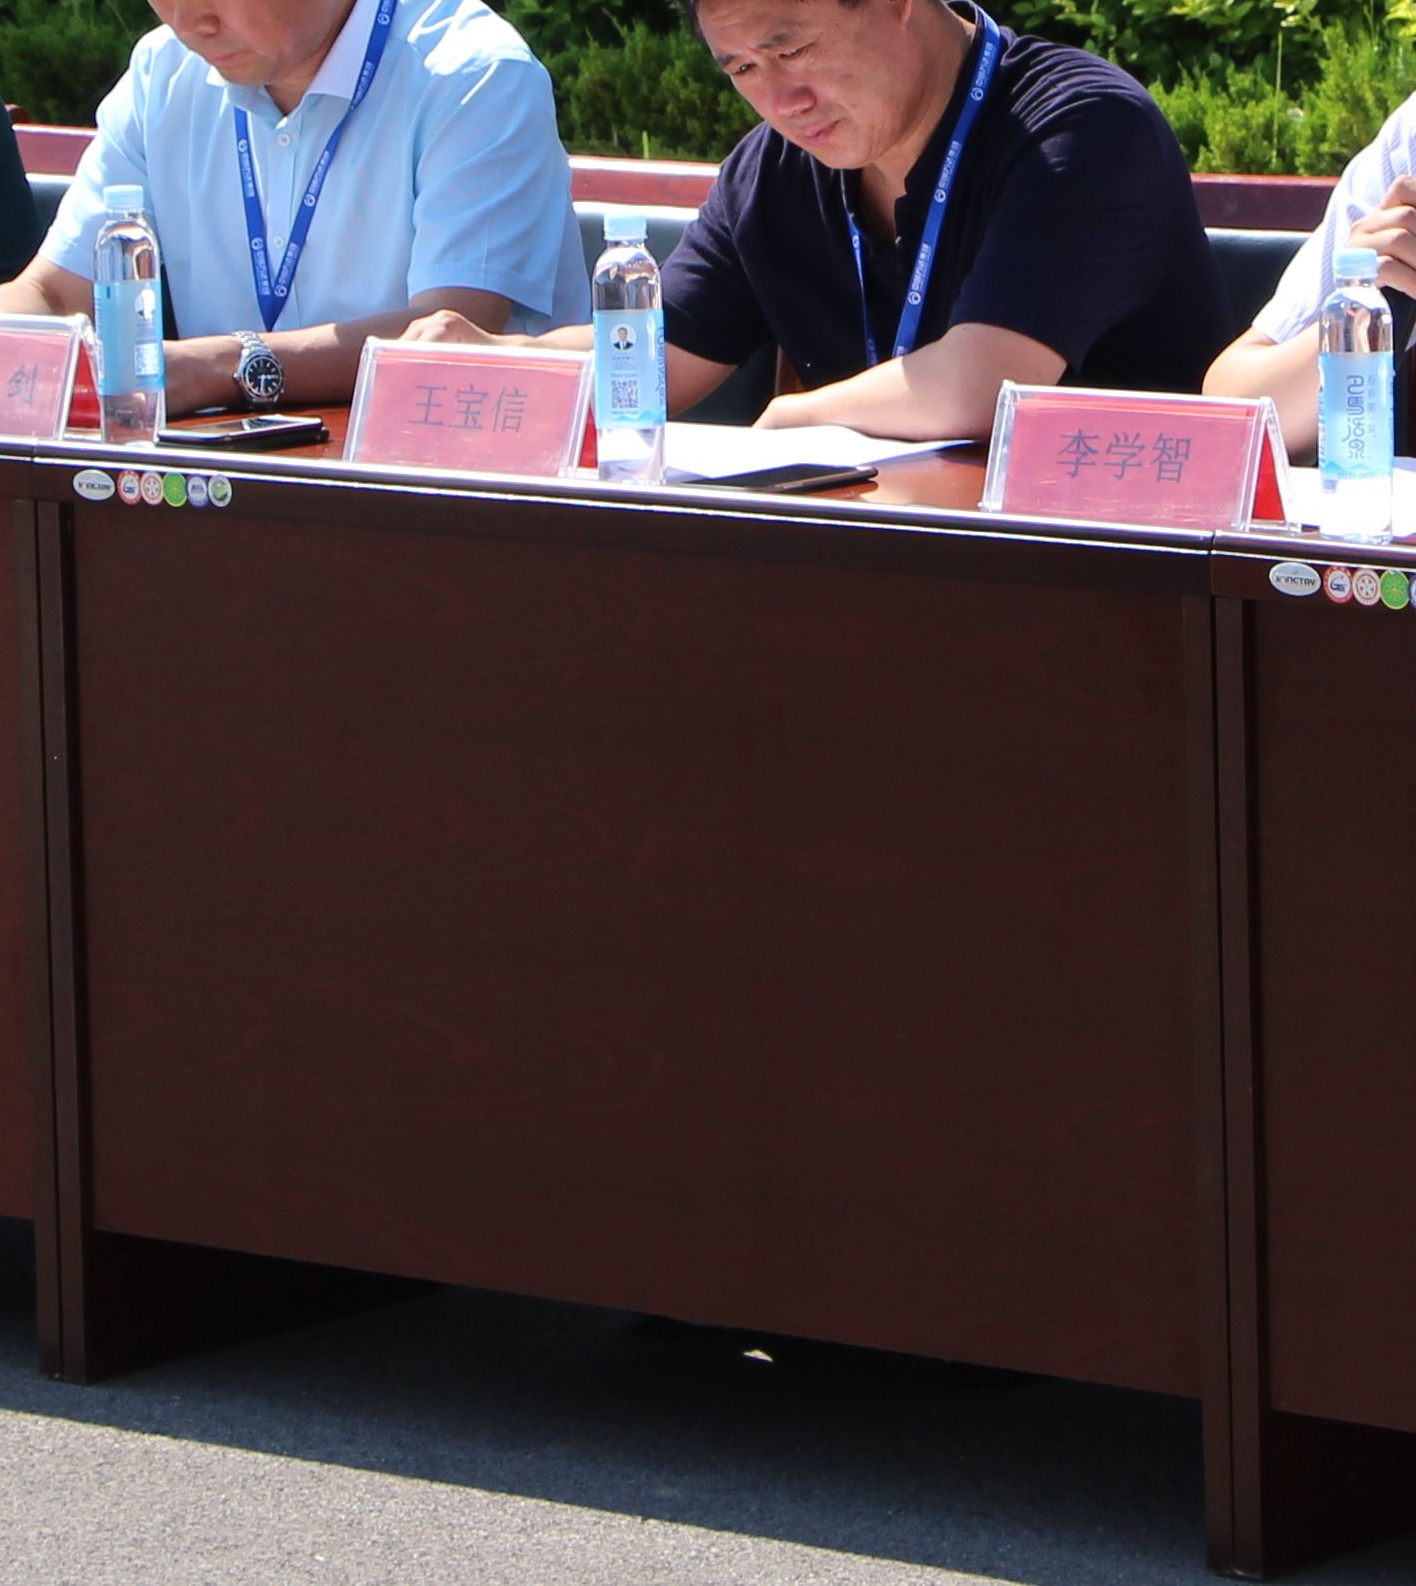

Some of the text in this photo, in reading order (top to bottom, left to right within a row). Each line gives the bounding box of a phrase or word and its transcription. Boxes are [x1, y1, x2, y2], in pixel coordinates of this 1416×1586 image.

[407, 381, 530, 435] 王宝信
[1055, 425, 1194, 485] 李学智
